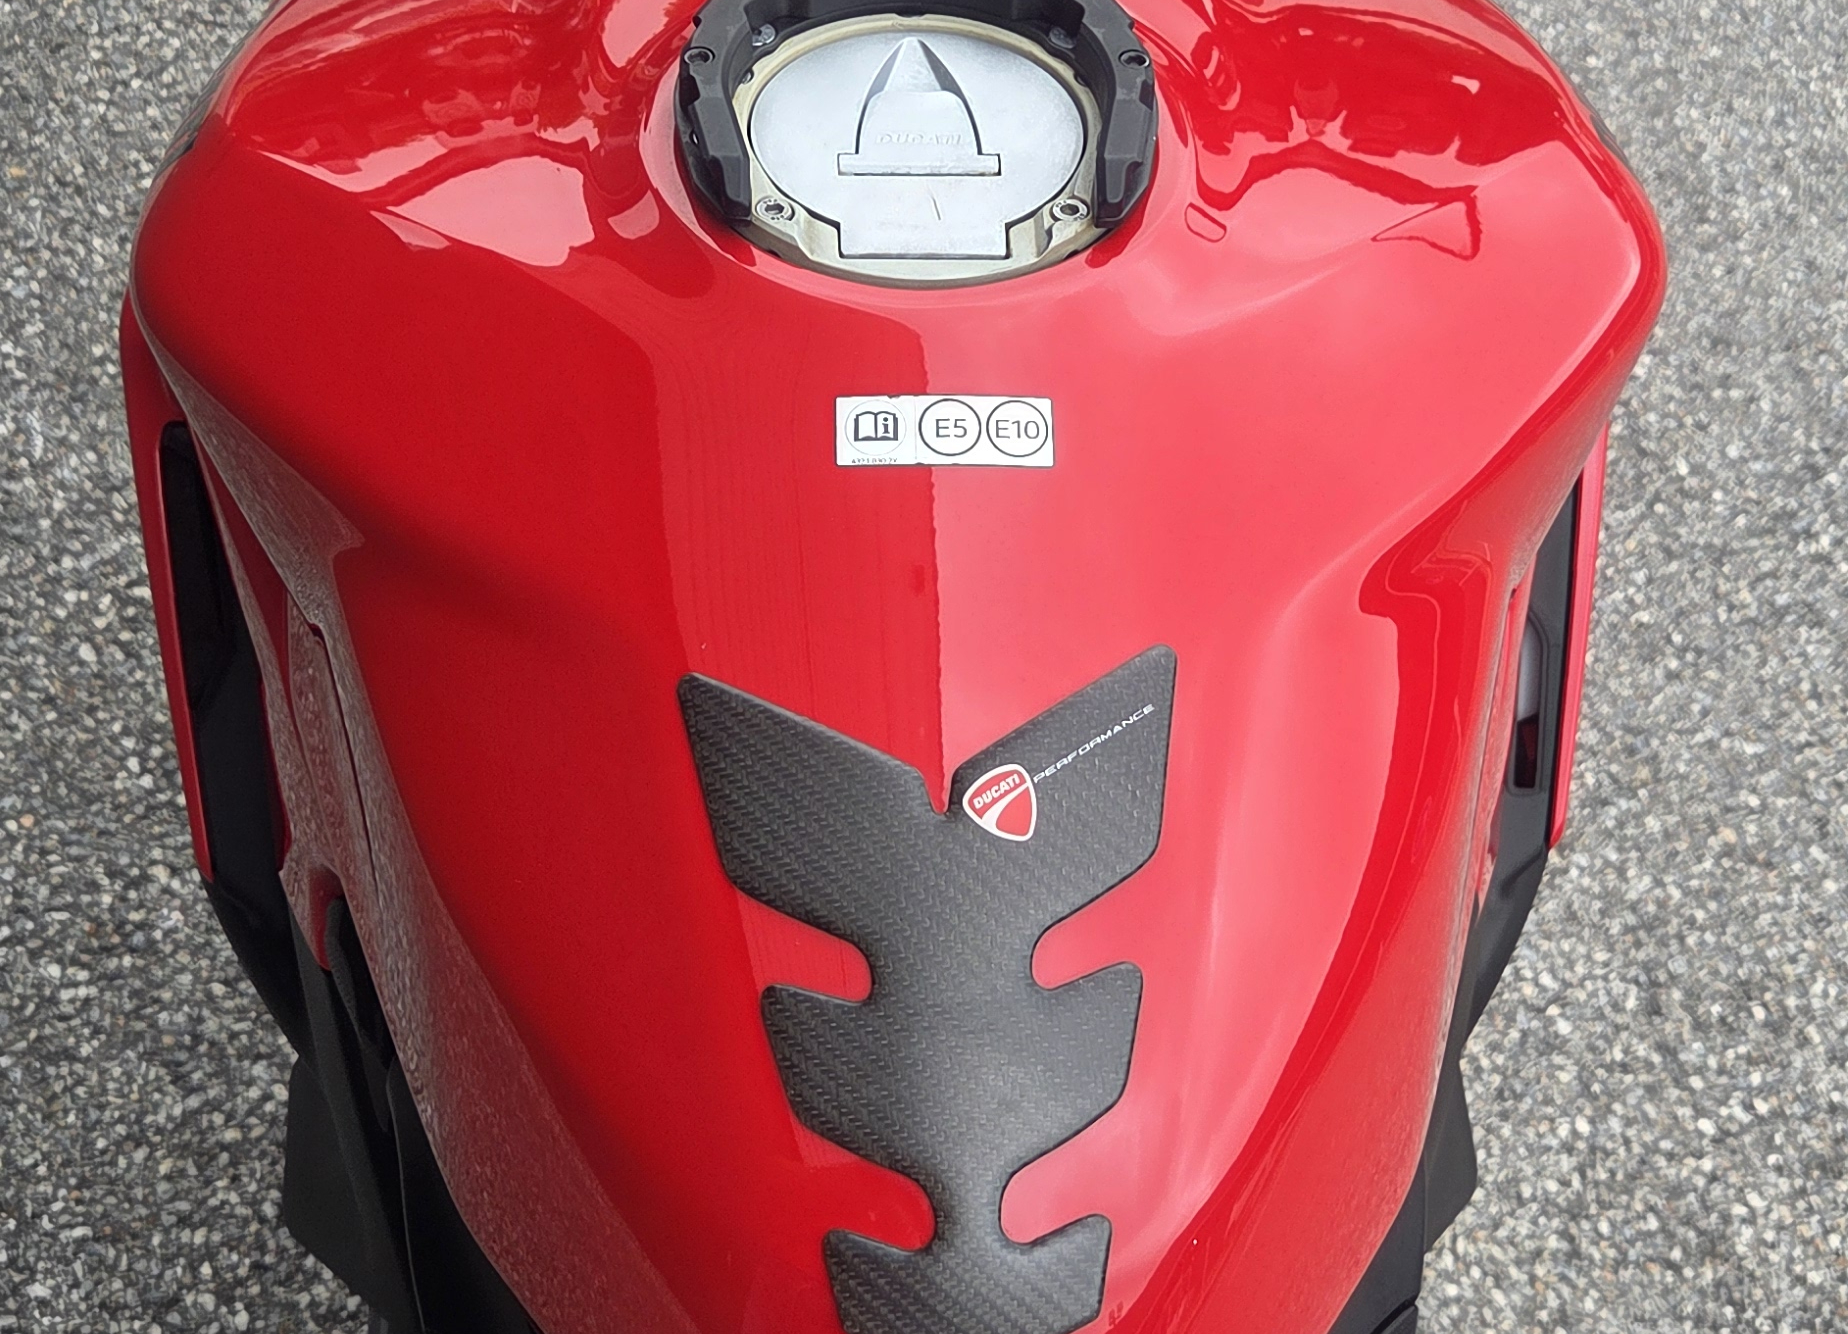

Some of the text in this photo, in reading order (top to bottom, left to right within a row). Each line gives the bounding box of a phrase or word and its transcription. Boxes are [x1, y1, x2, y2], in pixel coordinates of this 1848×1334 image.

[934, 418, 1041, 440] E5 E10
[972, 703, 1156, 810] DUCATI PERFORMANCE
